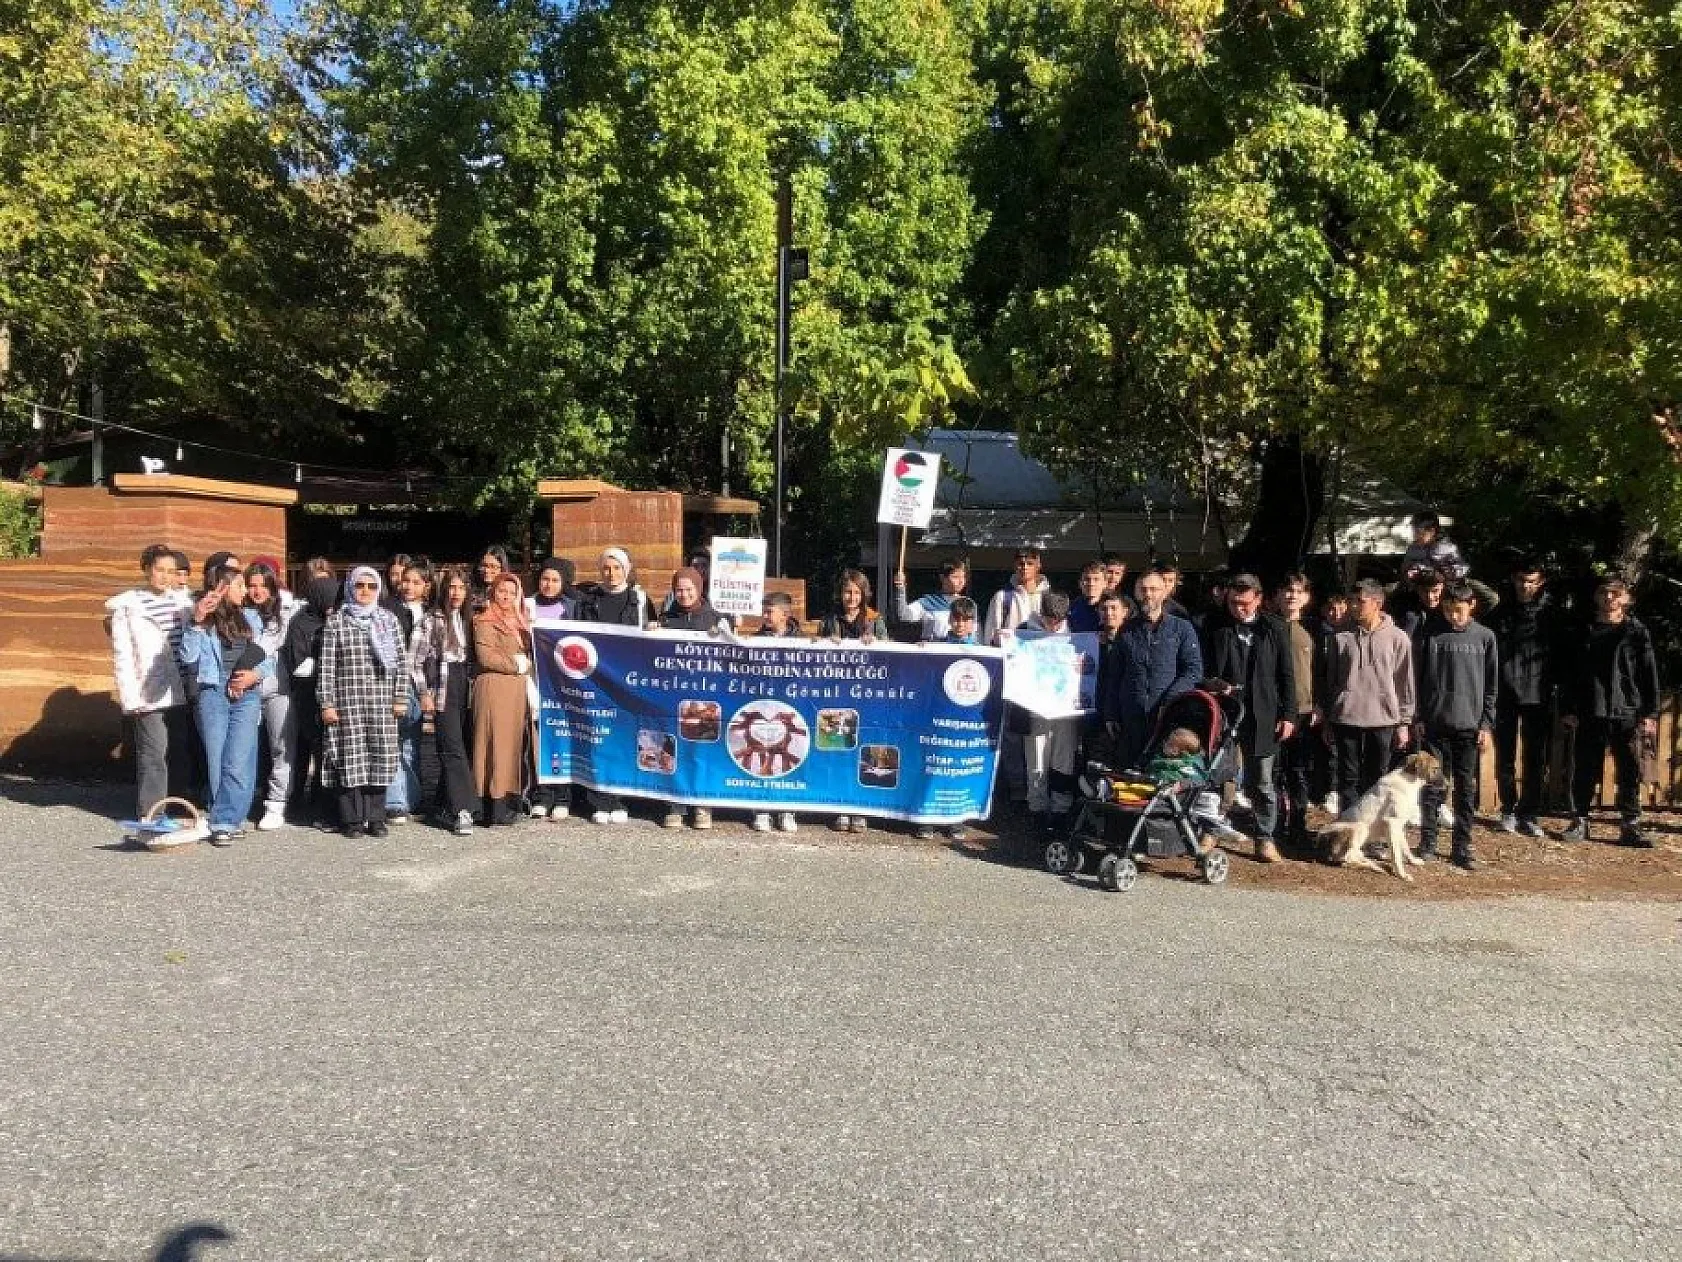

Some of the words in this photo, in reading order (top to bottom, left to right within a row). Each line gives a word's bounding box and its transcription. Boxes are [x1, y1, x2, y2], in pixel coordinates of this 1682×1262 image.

[714, 601, 754, 610] GELECEK
[748, 648, 779, 664] İLÇE
[784, 650, 868, 664] MÜFTÜLÜĞÜ
[654, 656, 723, 675] GENÇLİK
[728, 661, 888, 680] KOORDİNATÖRLÜĞÜ
[785, 683, 840, 699] Gönül
